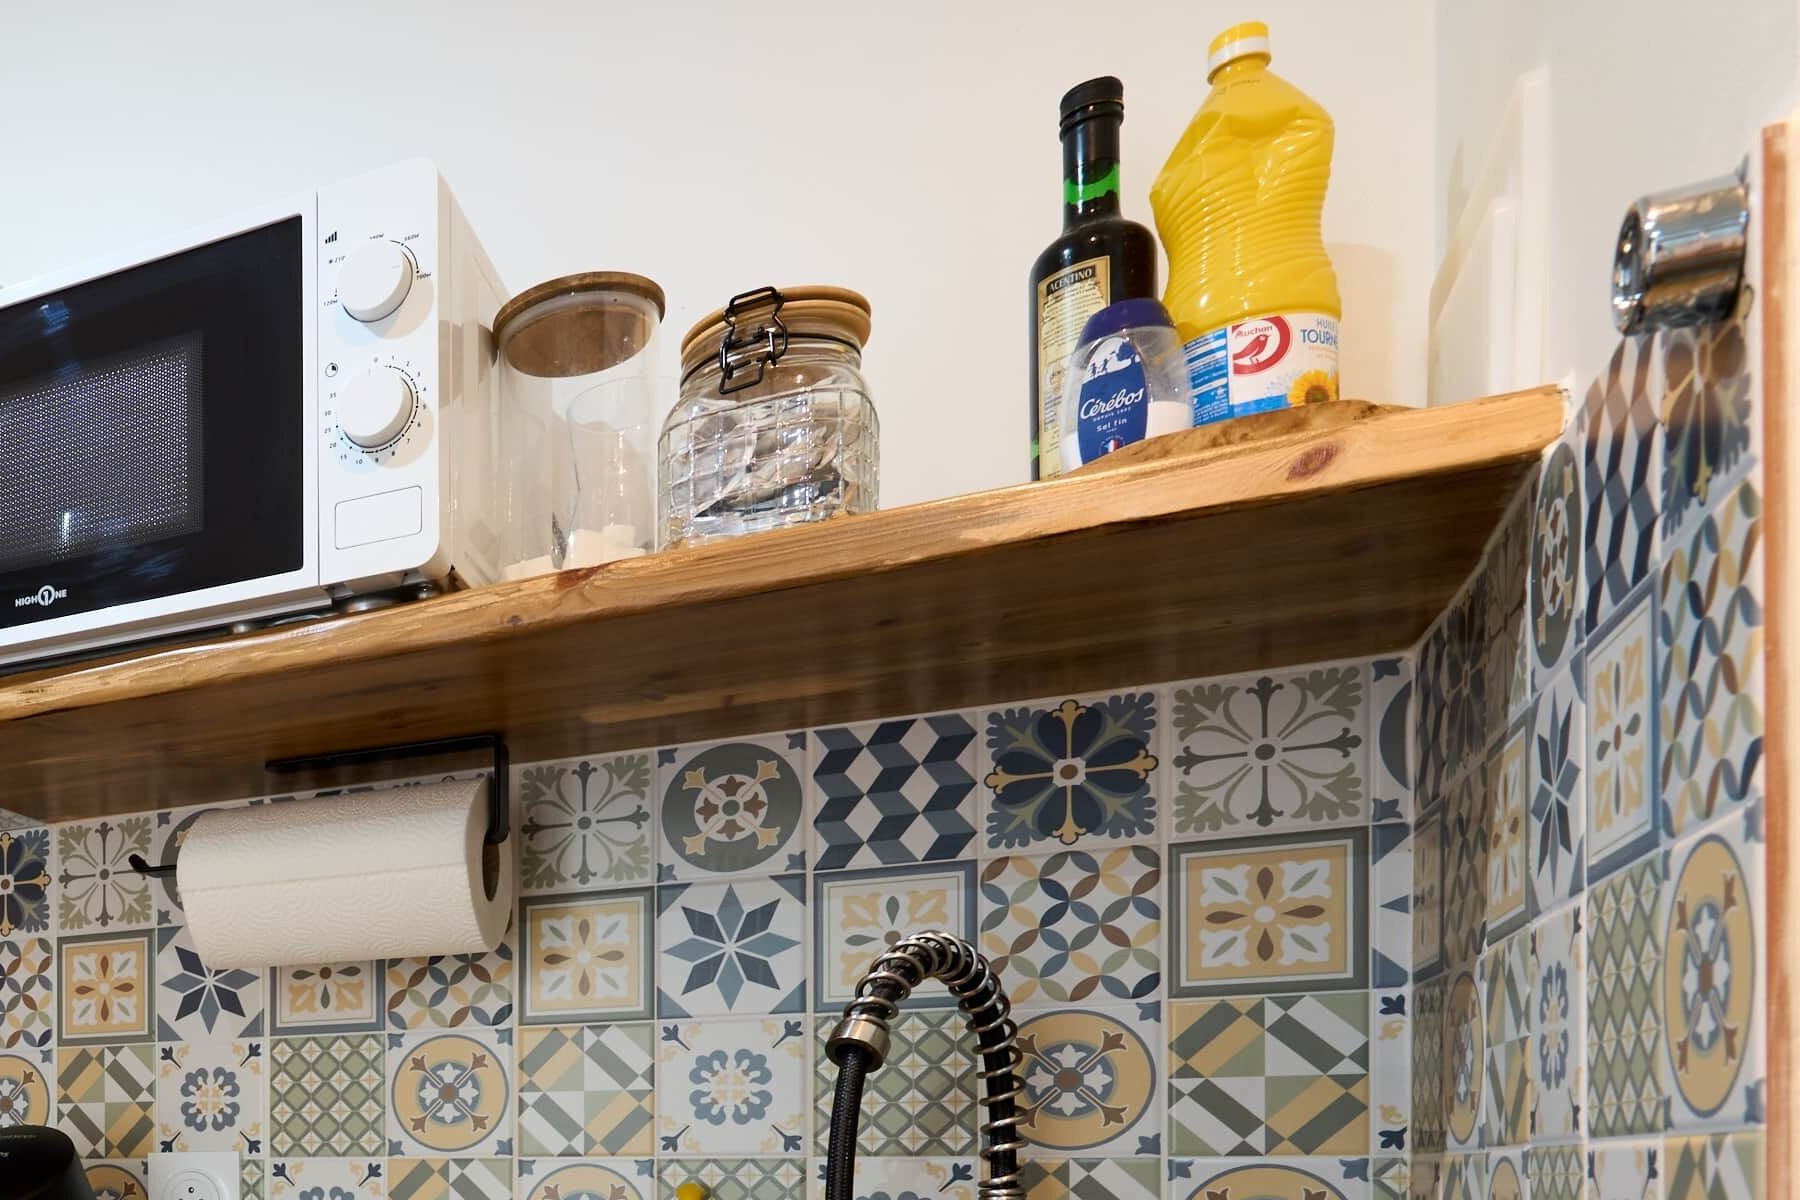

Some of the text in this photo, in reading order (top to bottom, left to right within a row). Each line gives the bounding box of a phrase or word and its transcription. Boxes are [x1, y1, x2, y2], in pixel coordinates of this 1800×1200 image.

[1235, 325, 1273, 338] Auchan
[1080, 388, 1145, 420] Cérébos
[1096, 422, 1111, 432] Sel
[1114, 418, 1127, 427] fin
